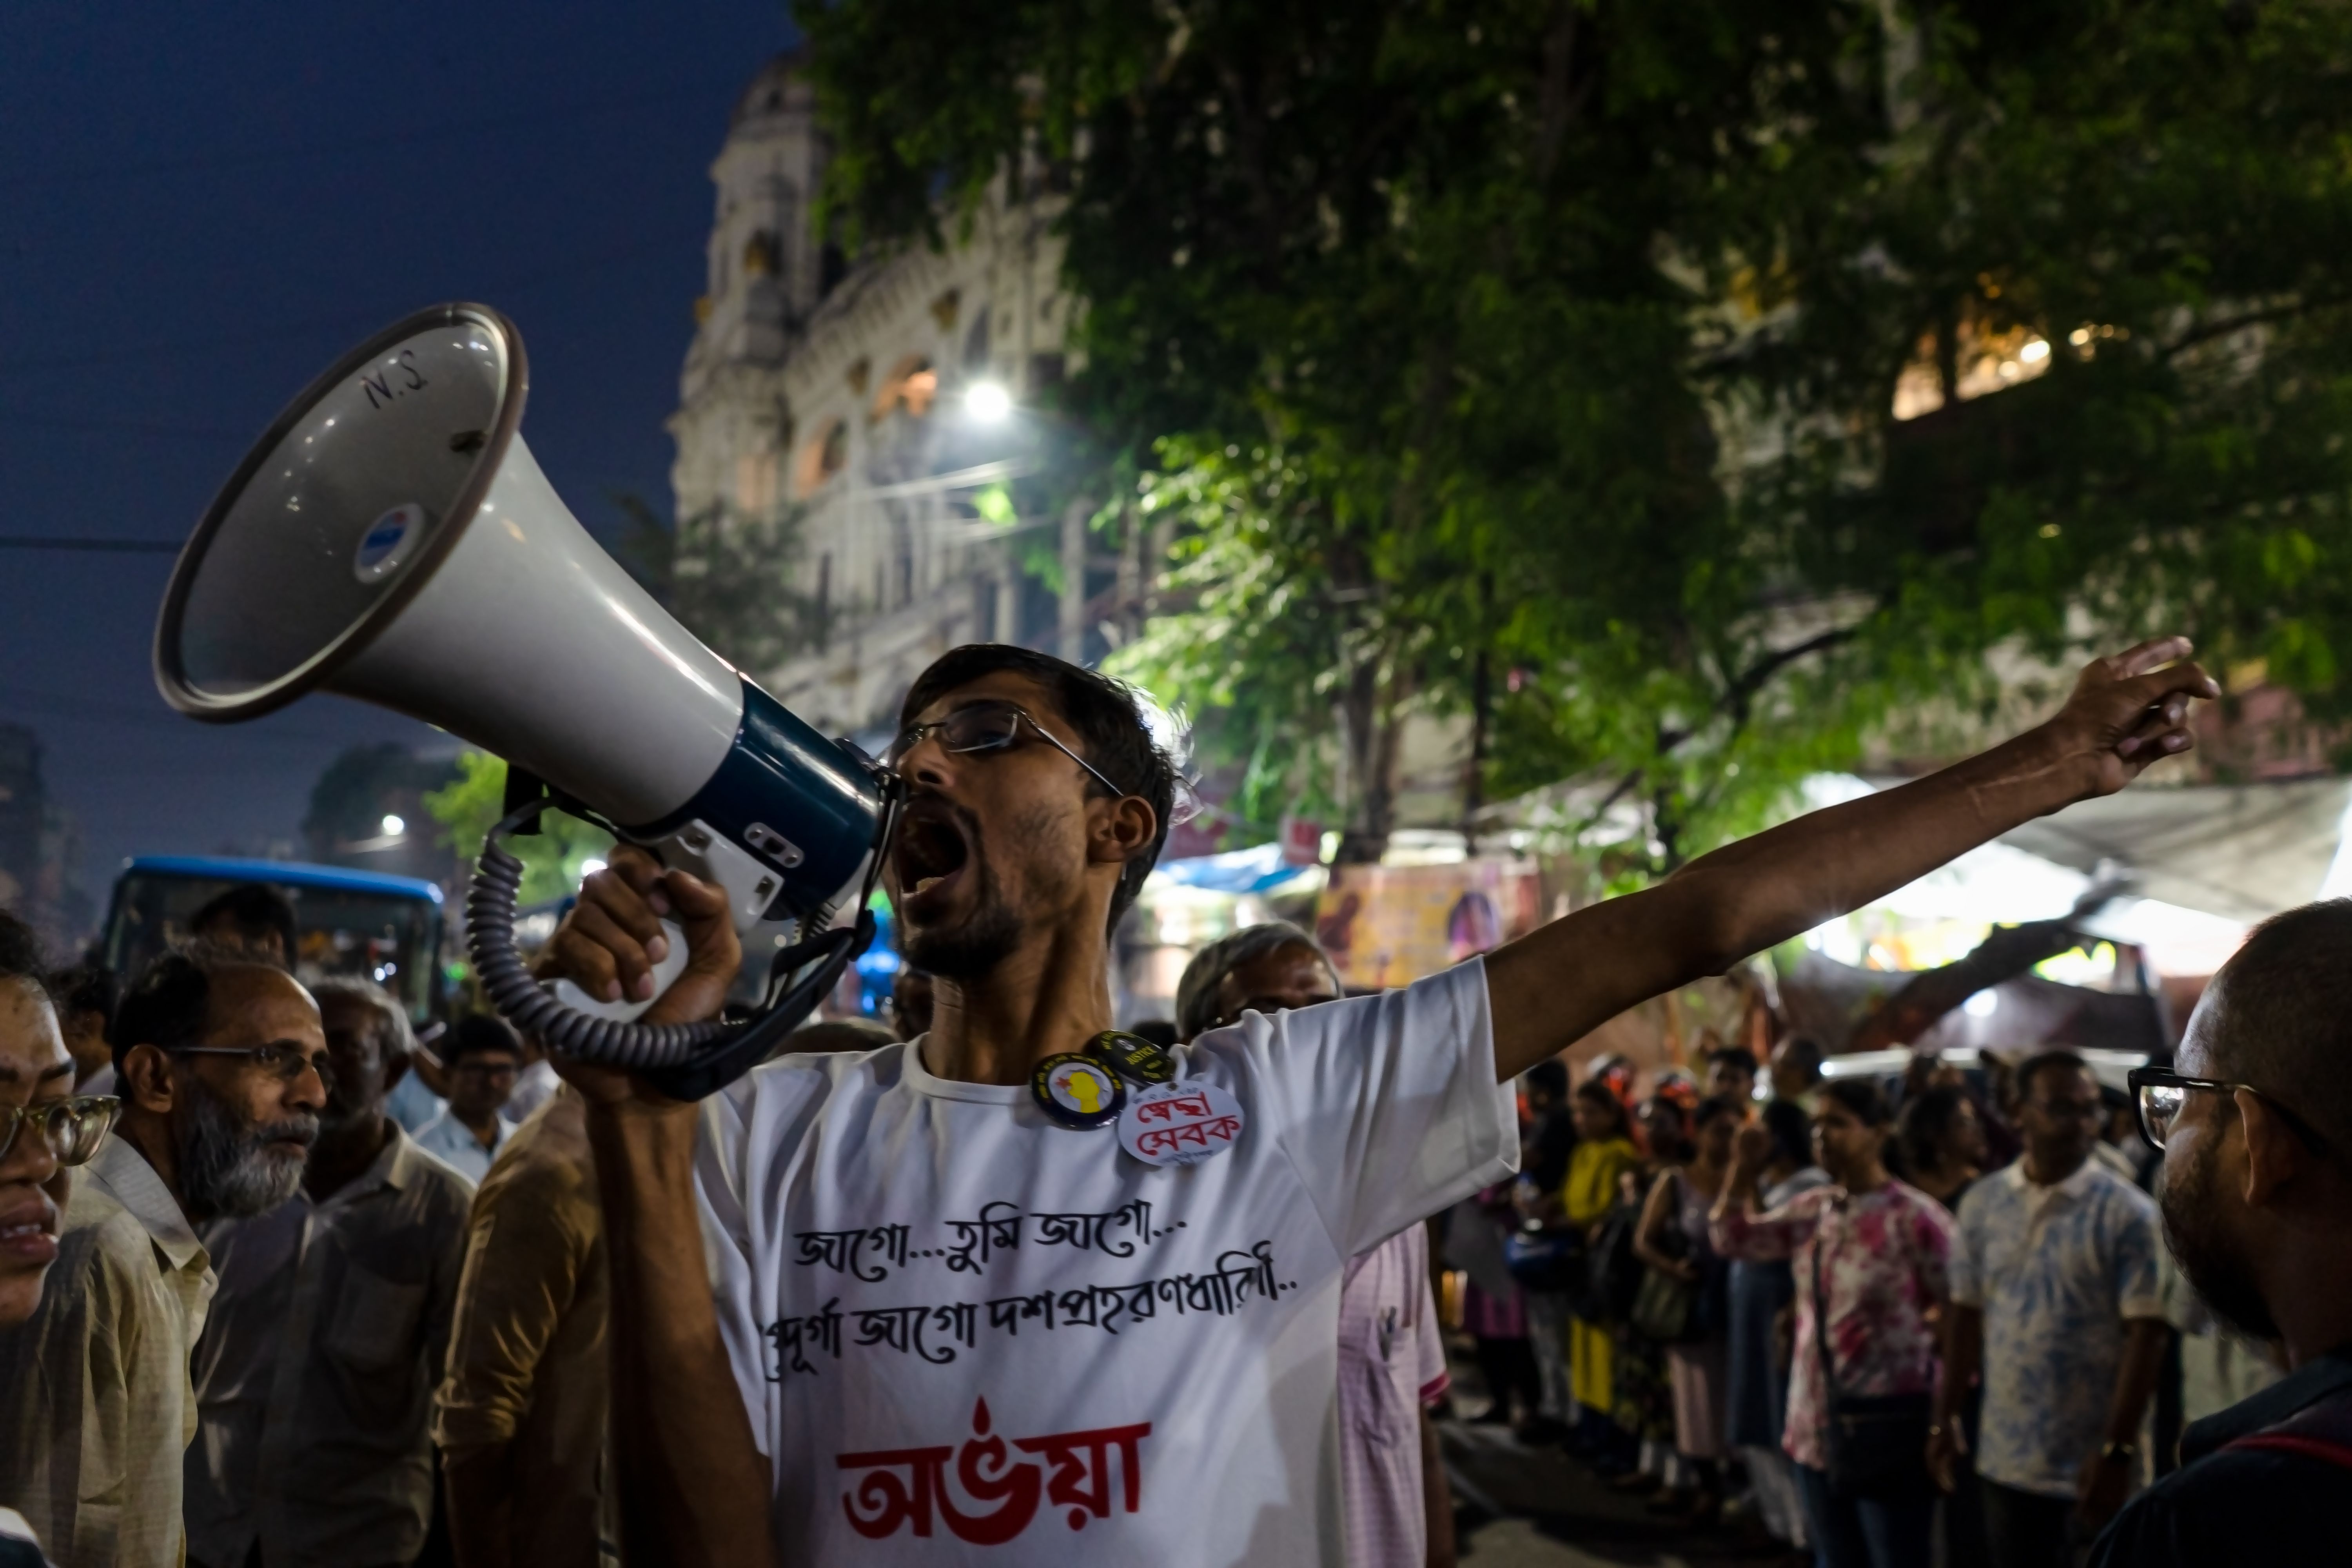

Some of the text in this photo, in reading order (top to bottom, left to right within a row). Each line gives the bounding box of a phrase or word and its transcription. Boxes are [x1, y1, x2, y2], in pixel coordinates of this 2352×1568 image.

[1125, 1046, 1157, 1065] JUSTICE
[1138, 1115, 1241, 1156] সেবক
[851, 1303, 978, 1364] জাগো
[837, 1396, 1151, 1545] অভয়া
